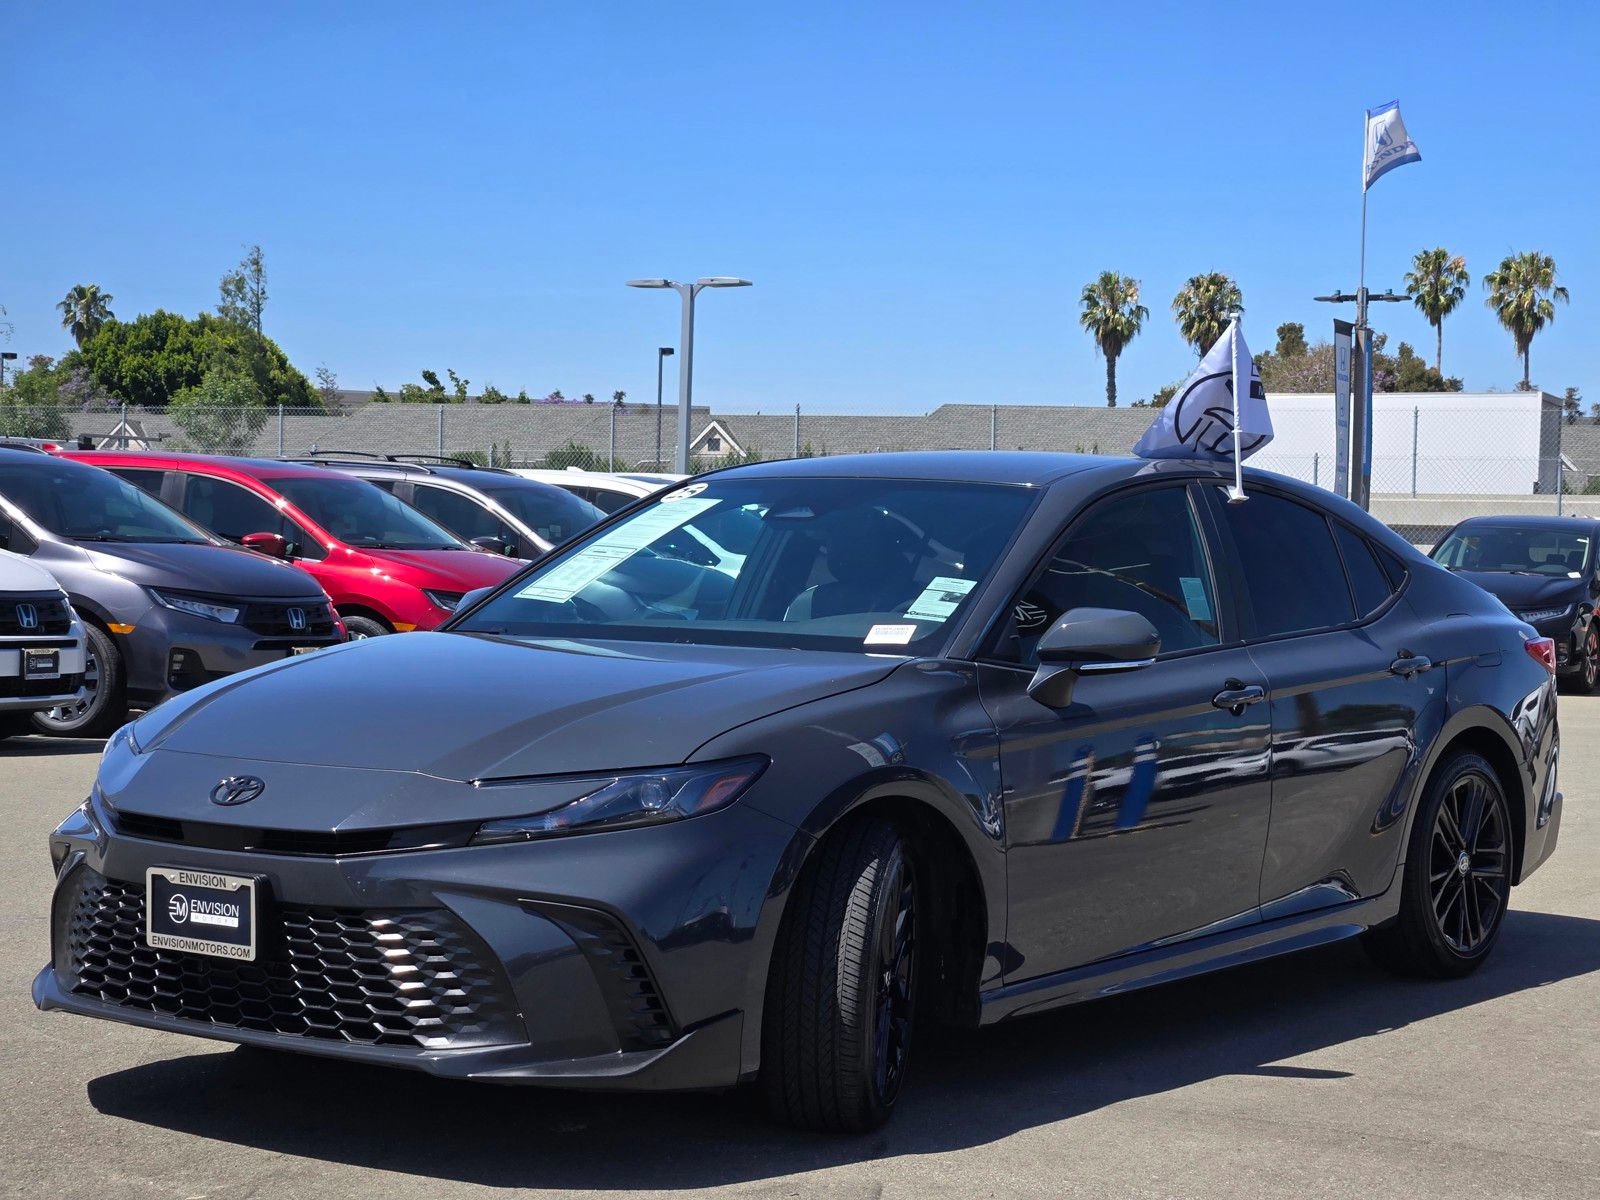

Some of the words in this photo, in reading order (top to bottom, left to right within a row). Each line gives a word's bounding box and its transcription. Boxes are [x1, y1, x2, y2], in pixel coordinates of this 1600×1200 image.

[179, 872, 227, 888] ENVISION
[190, 899, 240, 917] ENVISION
[152, 935, 251, 959] ENVISIONMOTORS.COM
